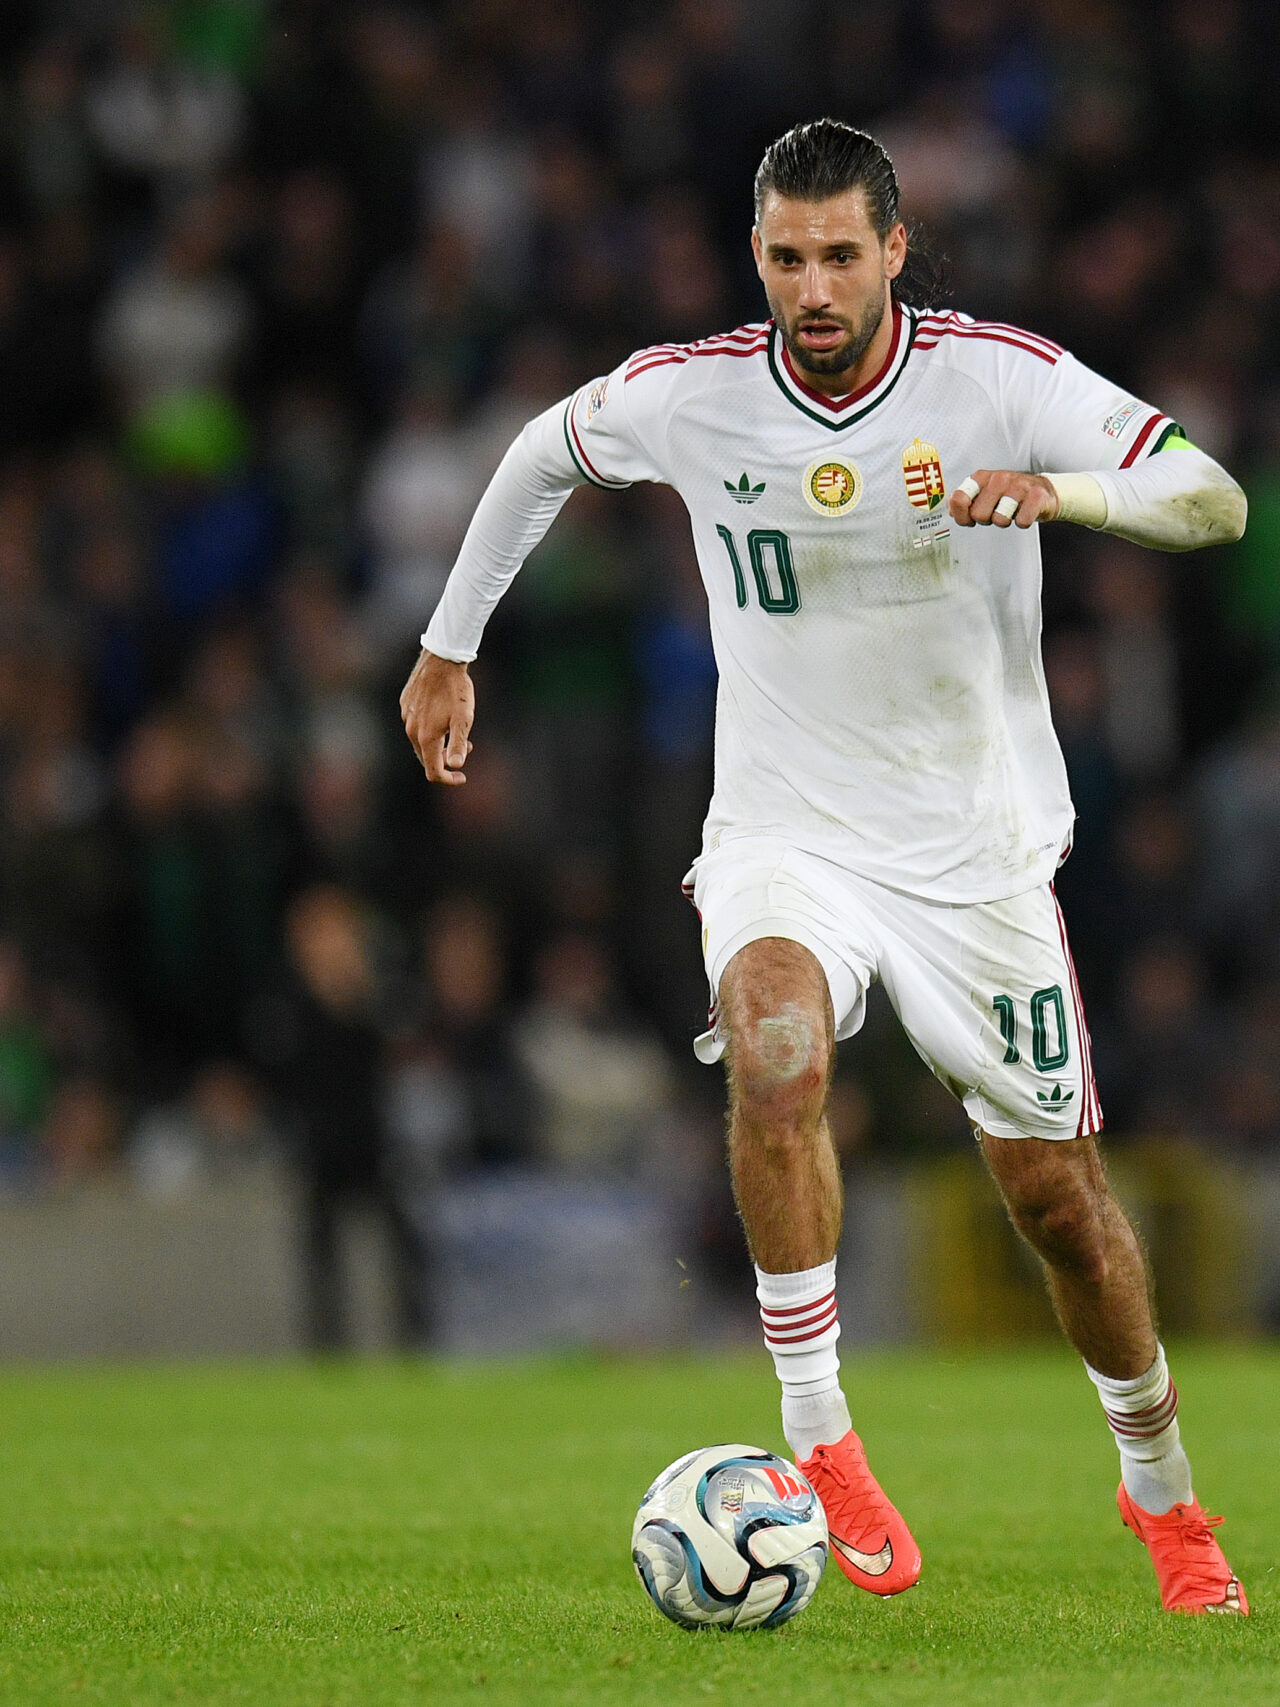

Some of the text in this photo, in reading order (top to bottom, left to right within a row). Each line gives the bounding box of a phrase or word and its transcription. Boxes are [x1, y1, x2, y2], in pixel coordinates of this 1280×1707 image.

[715, 523, 802, 616] 10
[919, 520, 941, 530] BELFAST
[993, 984, 1071, 1074] 10
